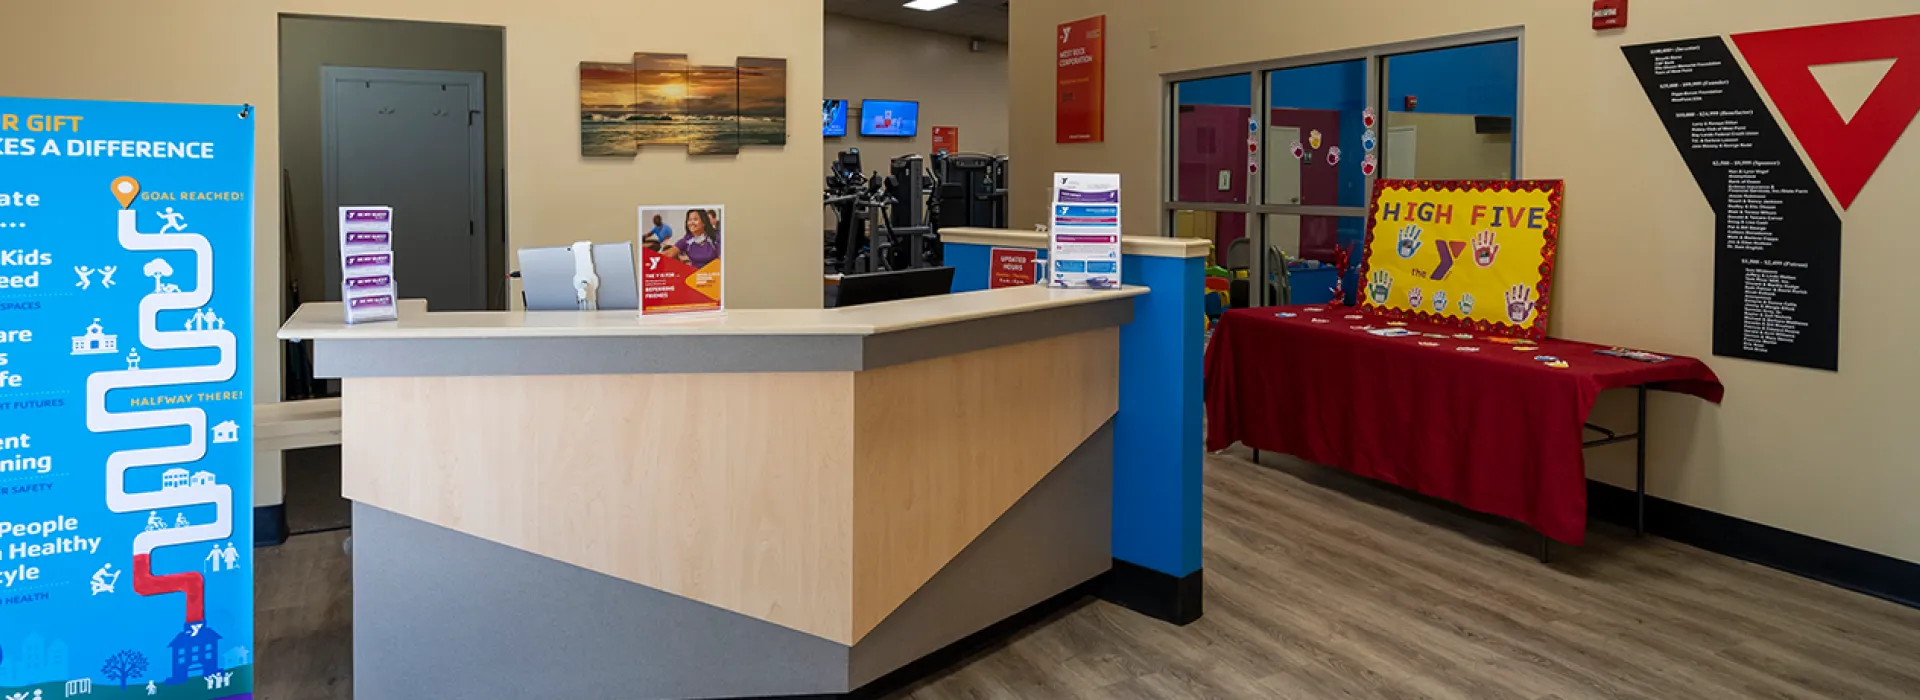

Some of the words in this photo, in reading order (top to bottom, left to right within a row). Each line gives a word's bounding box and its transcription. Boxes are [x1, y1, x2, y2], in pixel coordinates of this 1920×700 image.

[1059, 55, 1093, 67] CORPORATION
[27, 114, 83, 132] GIFT
[0, 138, 35, 156] ES
[41, 139, 61, 156] A
[67, 139, 214, 159] DIFFERENCE
[141, 191, 176, 201] GOAL
[180, 191, 244, 202] REACHED!
[1382, 202, 1453, 225] HIGH
[1471, 205, 1545, 229] FIVE
[1, 249, 53, 267] Kids
[1411, 268, 1427, 278] the
[1, 301, 41, 311] SPACES
[14, 398, 64, 409] FUTURES
[130, 394, 193, 407] HALFWAY
[197, 390, 243, 401] THERE!
[12, 483, 53, 494] SAFETY
[0, 514, 79, 538] People
[8, 535, 102, 560] Healthy
[5, 592, 50, 604] HEALTH
